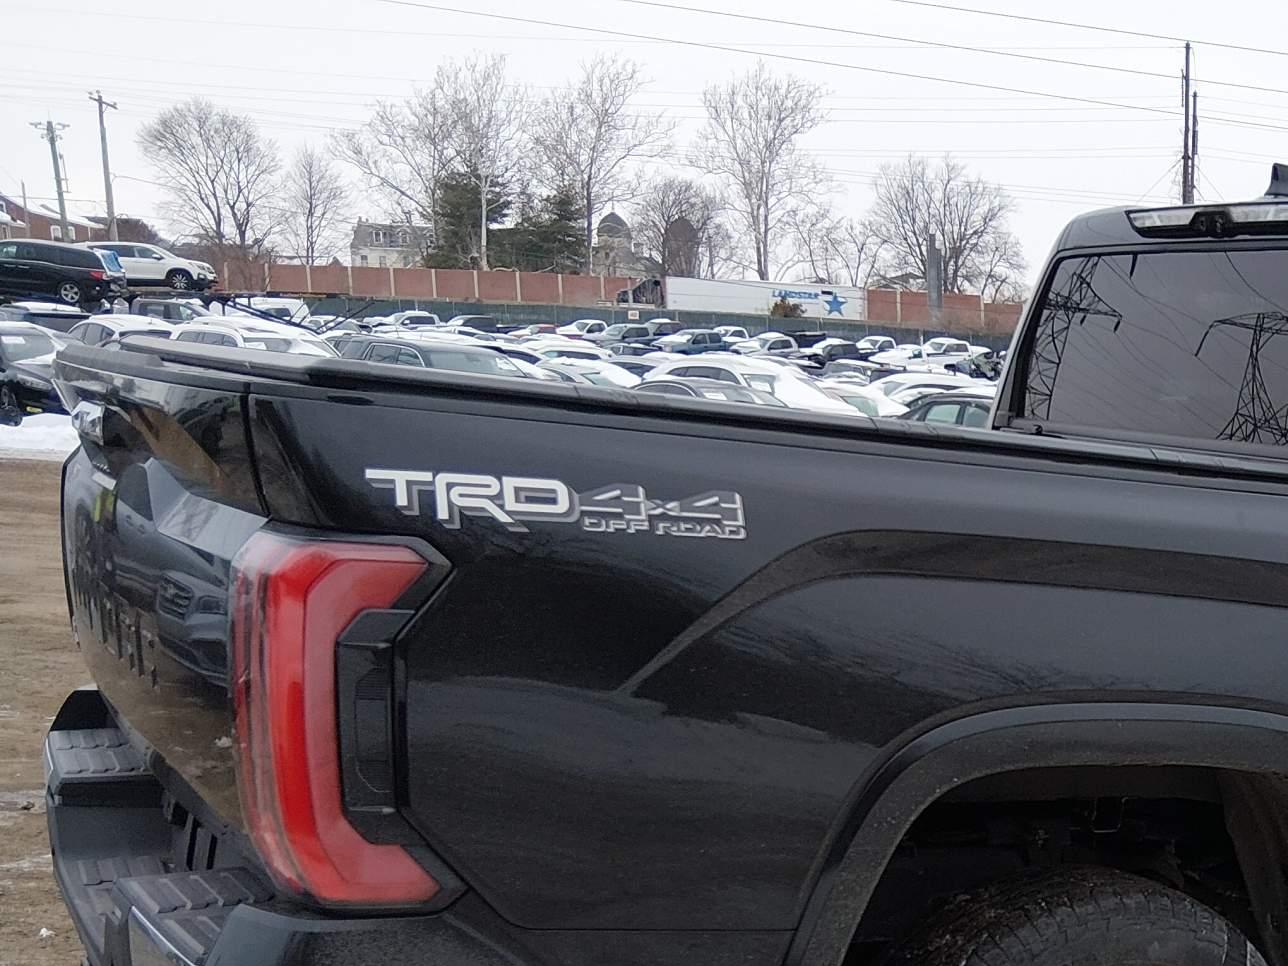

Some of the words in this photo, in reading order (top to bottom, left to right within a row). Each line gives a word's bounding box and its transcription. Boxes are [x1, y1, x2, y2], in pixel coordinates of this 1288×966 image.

[365, 468, 576, 531] TRD
[583, 515, 650, 534] OFF
[655, 520, 747, 540] ROAD
